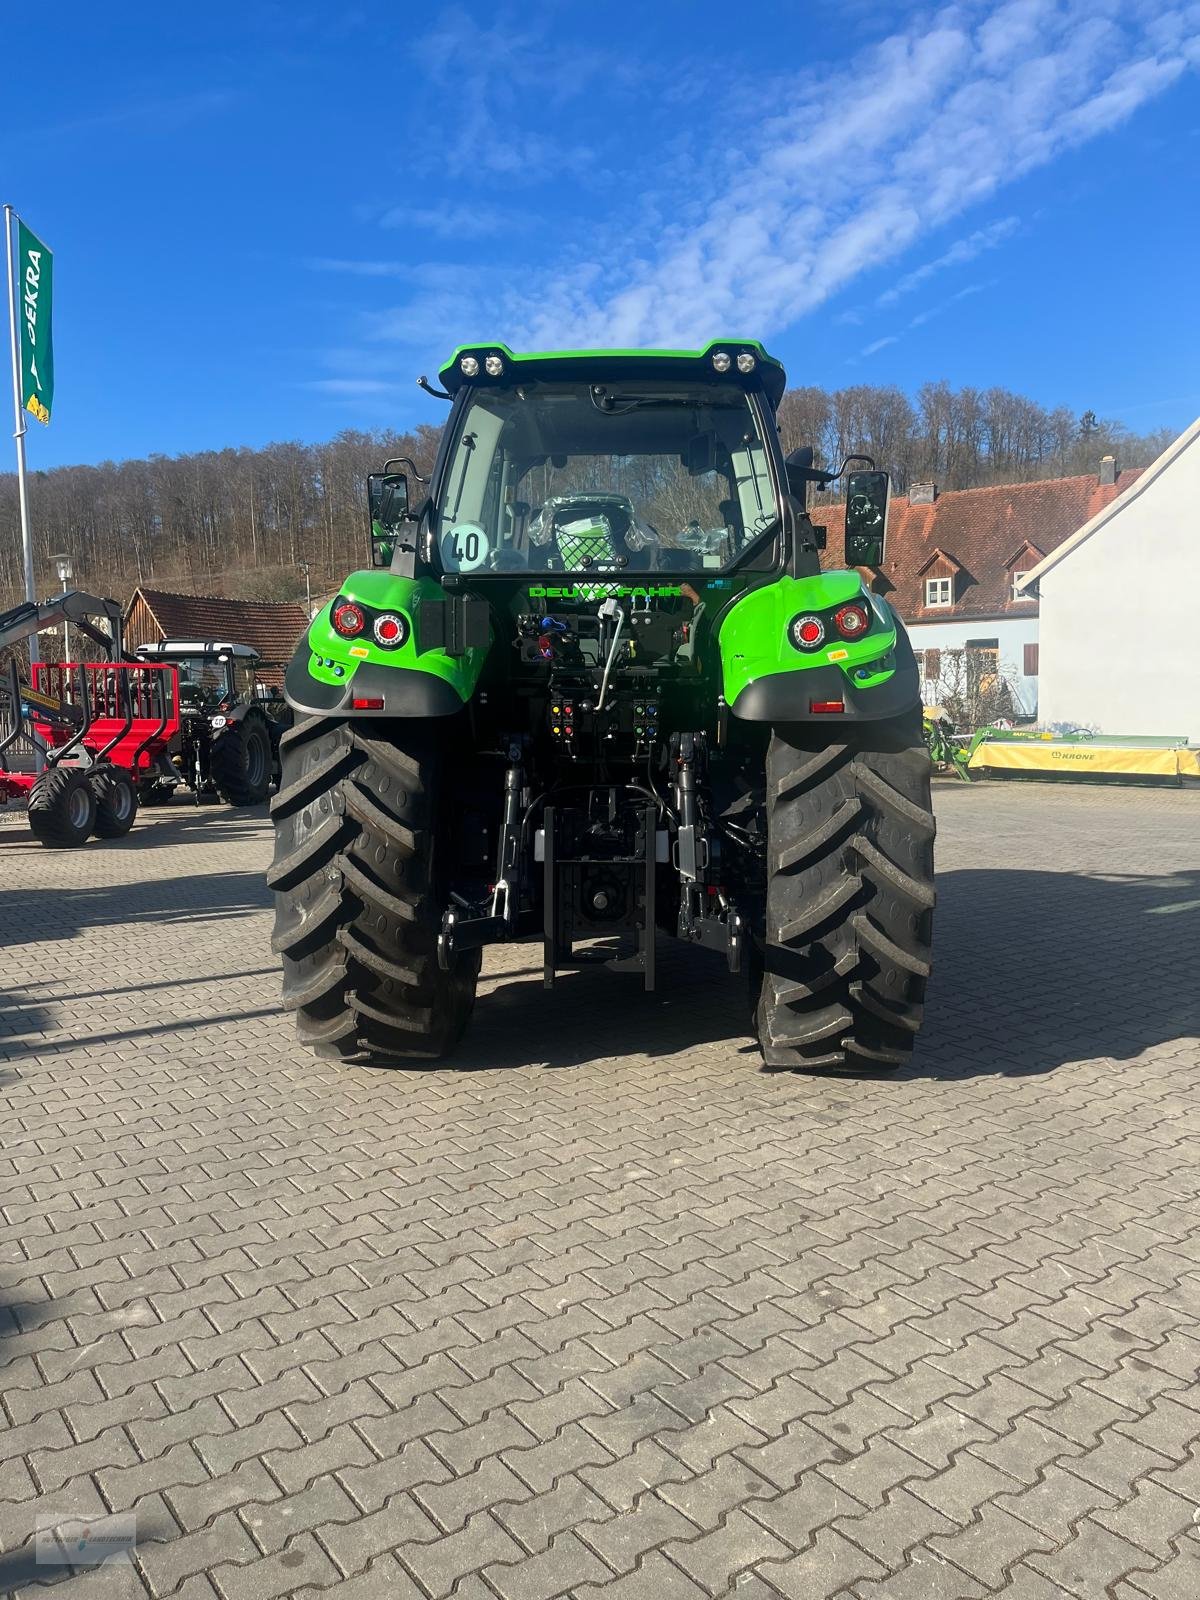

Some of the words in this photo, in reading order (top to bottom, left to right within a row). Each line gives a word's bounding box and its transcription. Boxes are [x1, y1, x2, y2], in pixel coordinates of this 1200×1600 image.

[25, 250, 42, 346] DEKRA
[452, 533, 479, 562] 40
[528, 587, 682, 597] DEUTZ-FAHR
[214, 718, 224, 726] 40
